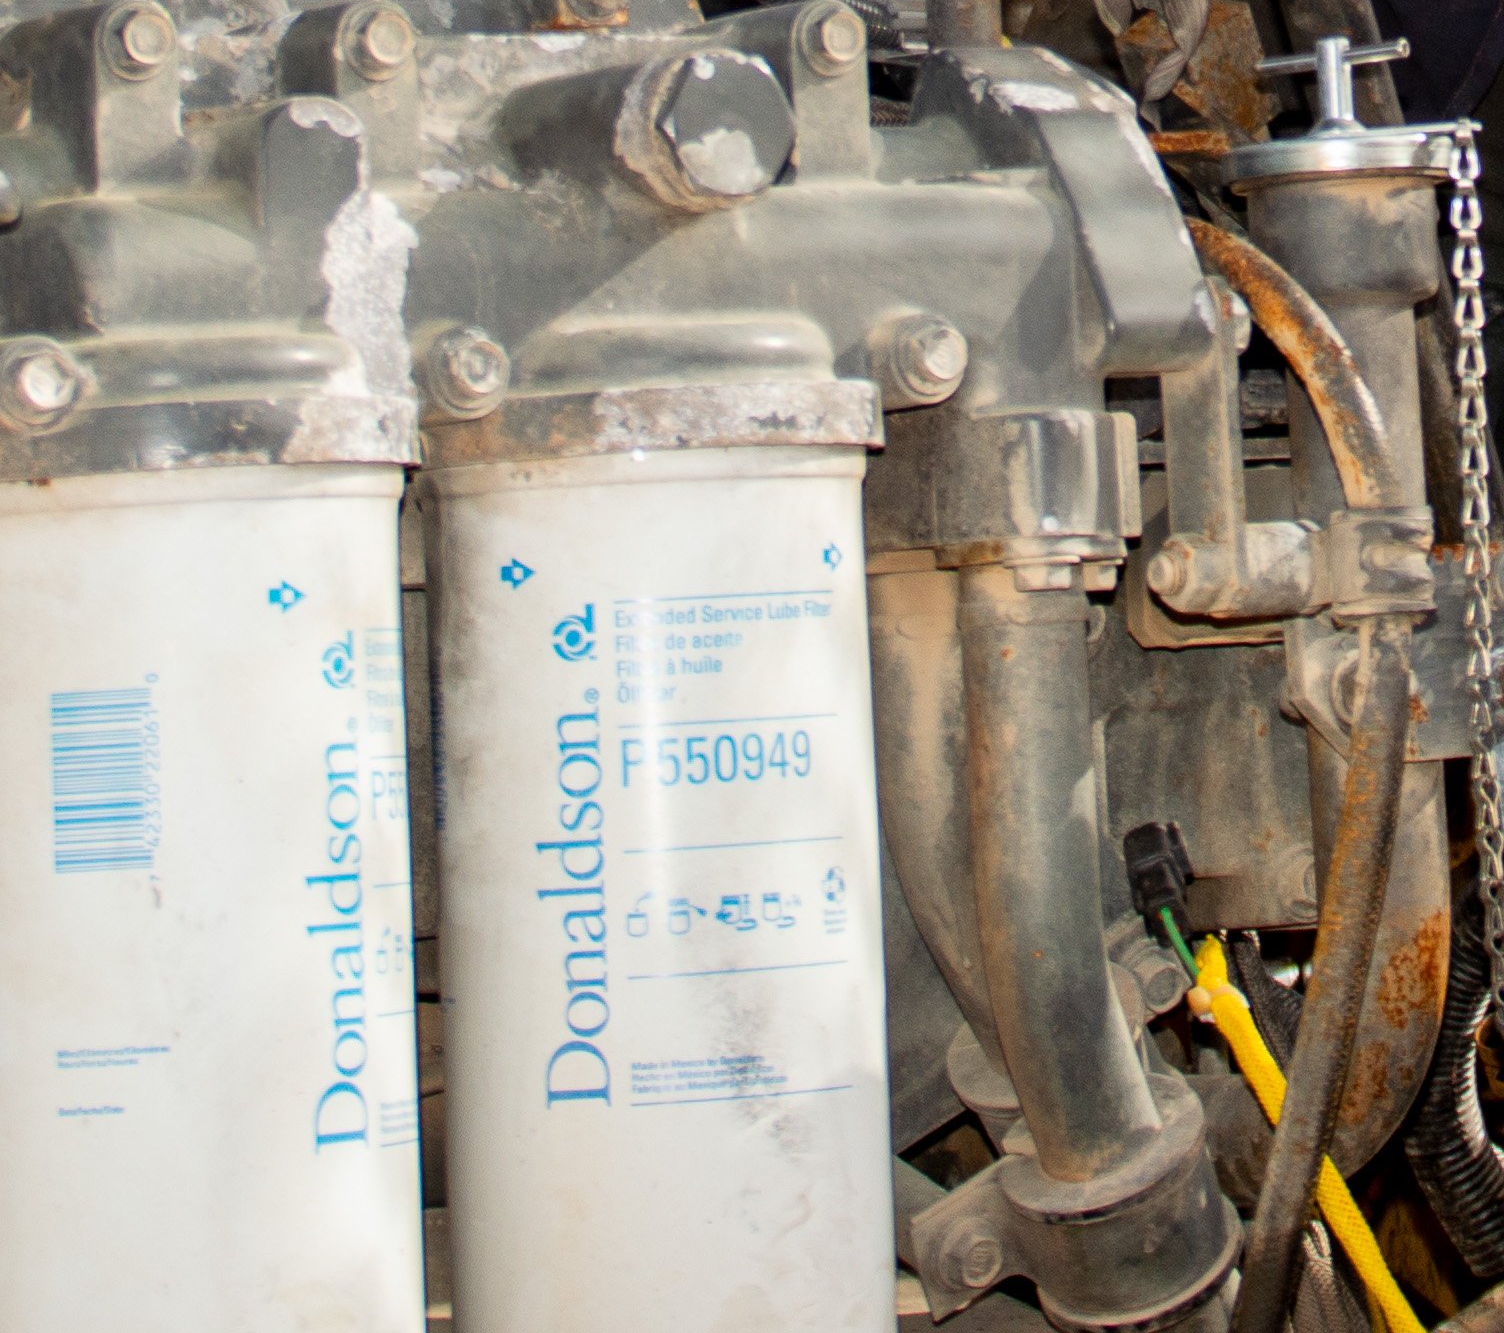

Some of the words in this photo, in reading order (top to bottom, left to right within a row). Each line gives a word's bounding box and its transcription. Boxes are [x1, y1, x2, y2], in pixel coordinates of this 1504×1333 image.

[767, 601, 801, 620] Lube
[665, 632, 686, 651] de
[681, 655, 722, 675] huile
[536, 709, 613, 1110] Donaldson
[305, 742, 371, 1156] Donaldson
